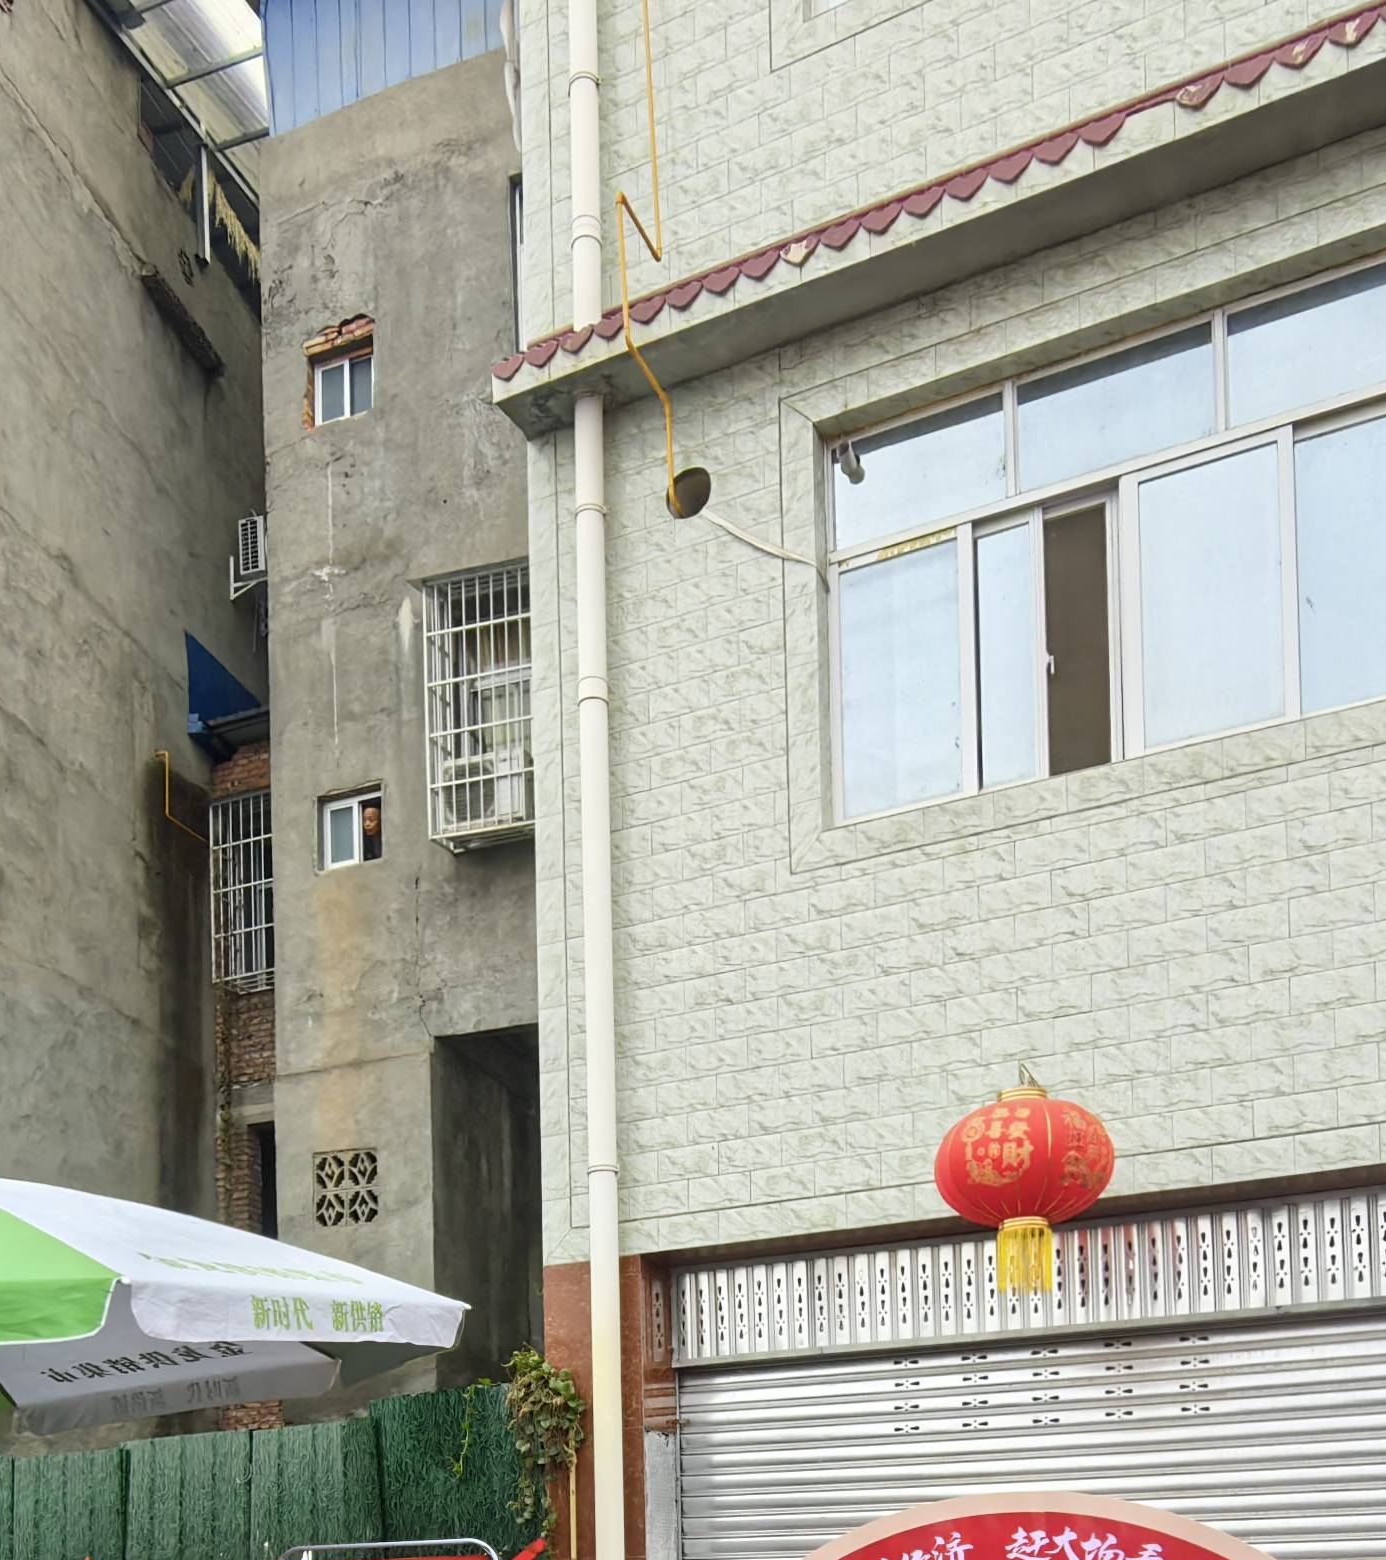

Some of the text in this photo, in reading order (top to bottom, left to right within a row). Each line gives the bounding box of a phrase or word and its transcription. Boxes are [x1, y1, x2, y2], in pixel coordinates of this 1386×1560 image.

[251, 1296, 386, 1334] 新时代 新供销
